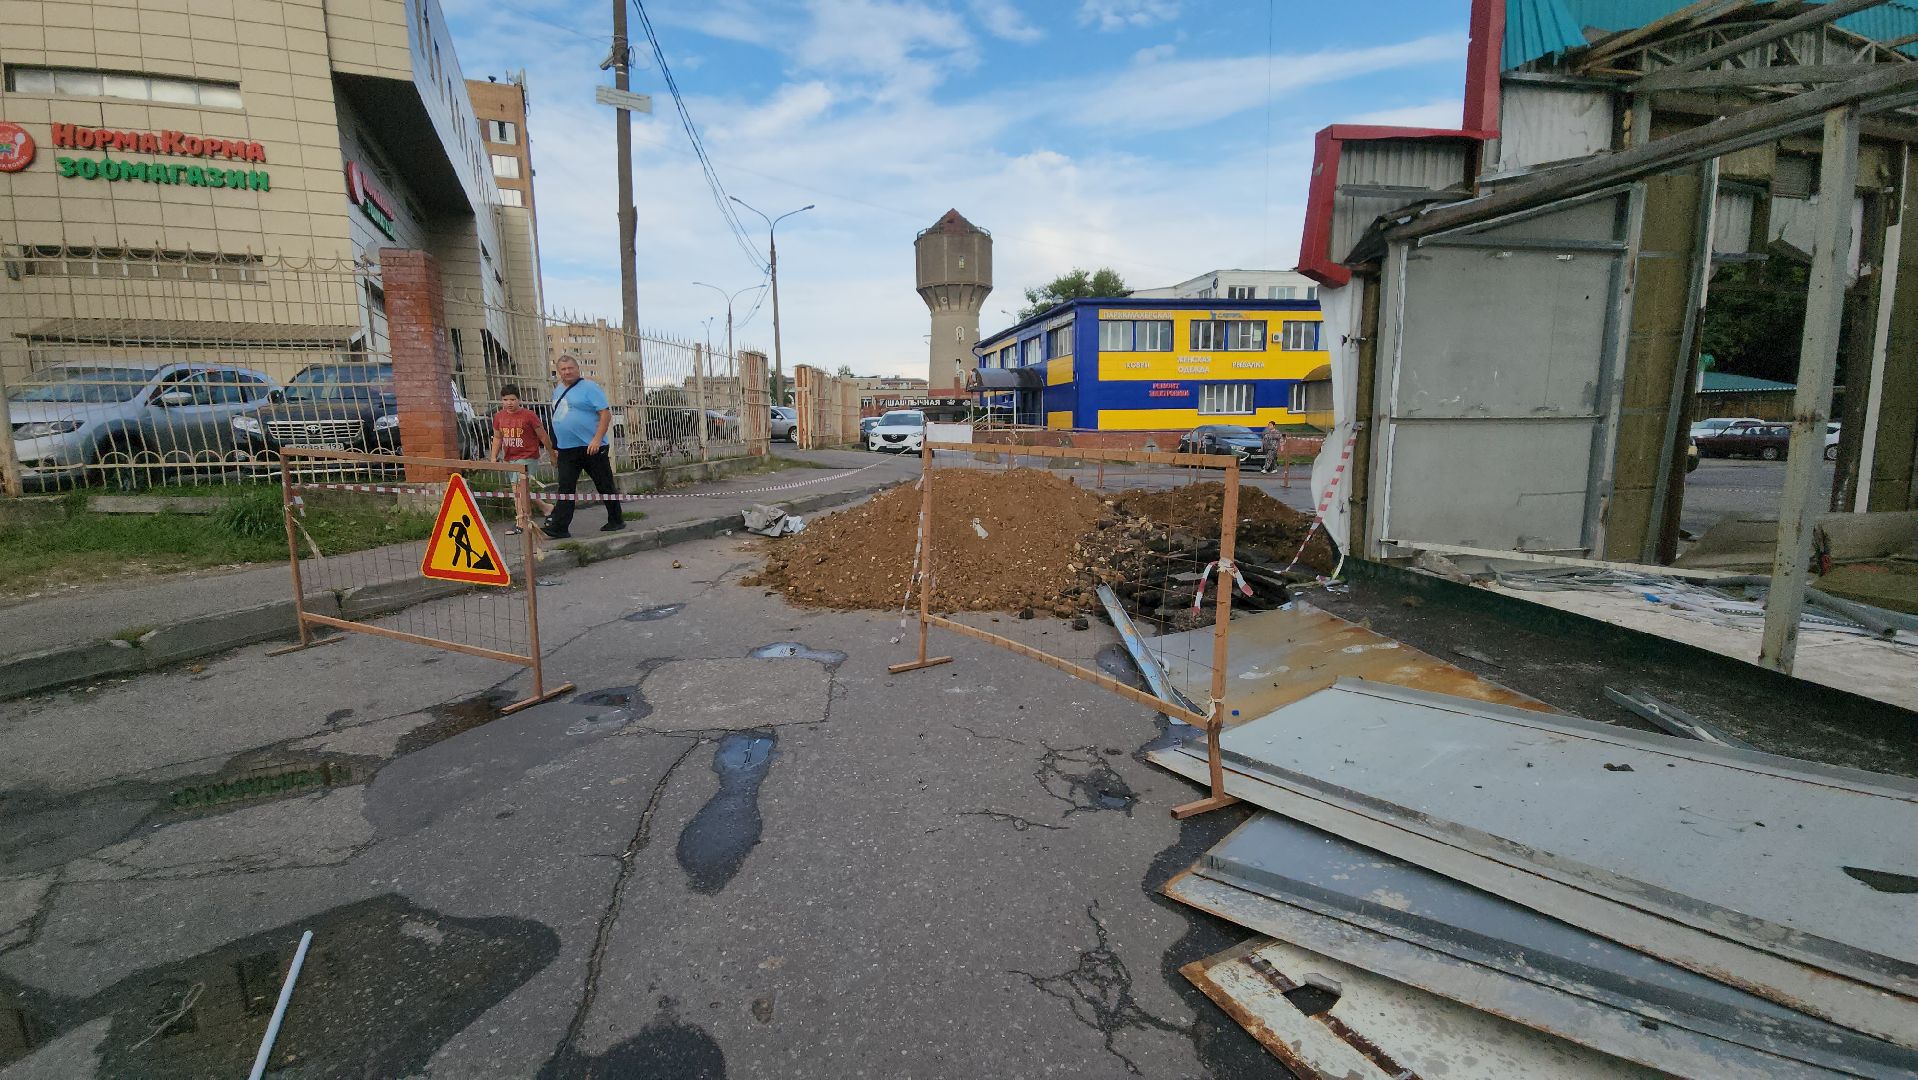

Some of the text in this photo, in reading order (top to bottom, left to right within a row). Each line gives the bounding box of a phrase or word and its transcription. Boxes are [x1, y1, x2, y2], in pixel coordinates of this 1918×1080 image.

[56, 156, 271, 192] ЗООМАГАЗИН
[1103, 311, 1172, 320] ПАРИКМАХЕРСКАЯ
[887, 399, 941, 407] ШАШЛЫЧНАЯ
